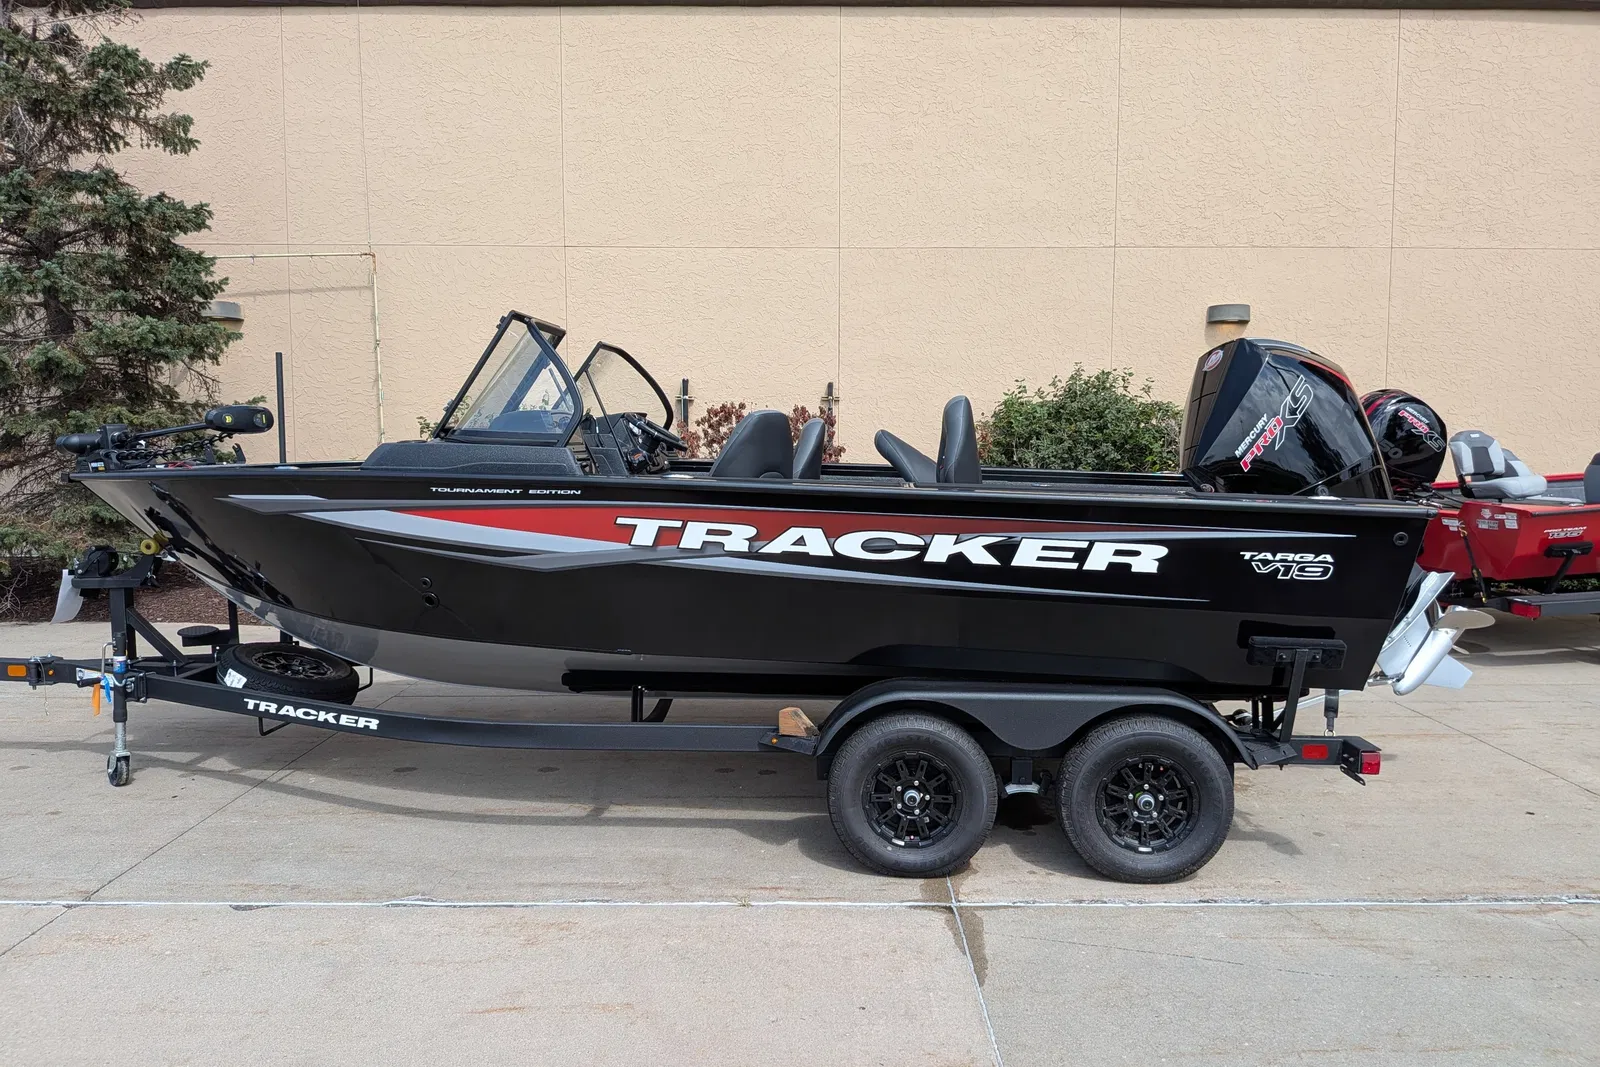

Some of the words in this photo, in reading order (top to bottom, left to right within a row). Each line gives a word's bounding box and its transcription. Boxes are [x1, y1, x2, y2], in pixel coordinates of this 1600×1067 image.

[1234, 413, 1268, 458] MERCURY
[430, 486, 523, 495] TOURNAMENT
[528, 488, 582, 496] EDITION
[614, 516, 1170, 575] TRACKER
[1239, 551, 1335, 563] TARGA
[1250, 561, 1334, 581] V19
[243, 698, 380, 730] TRACKER
